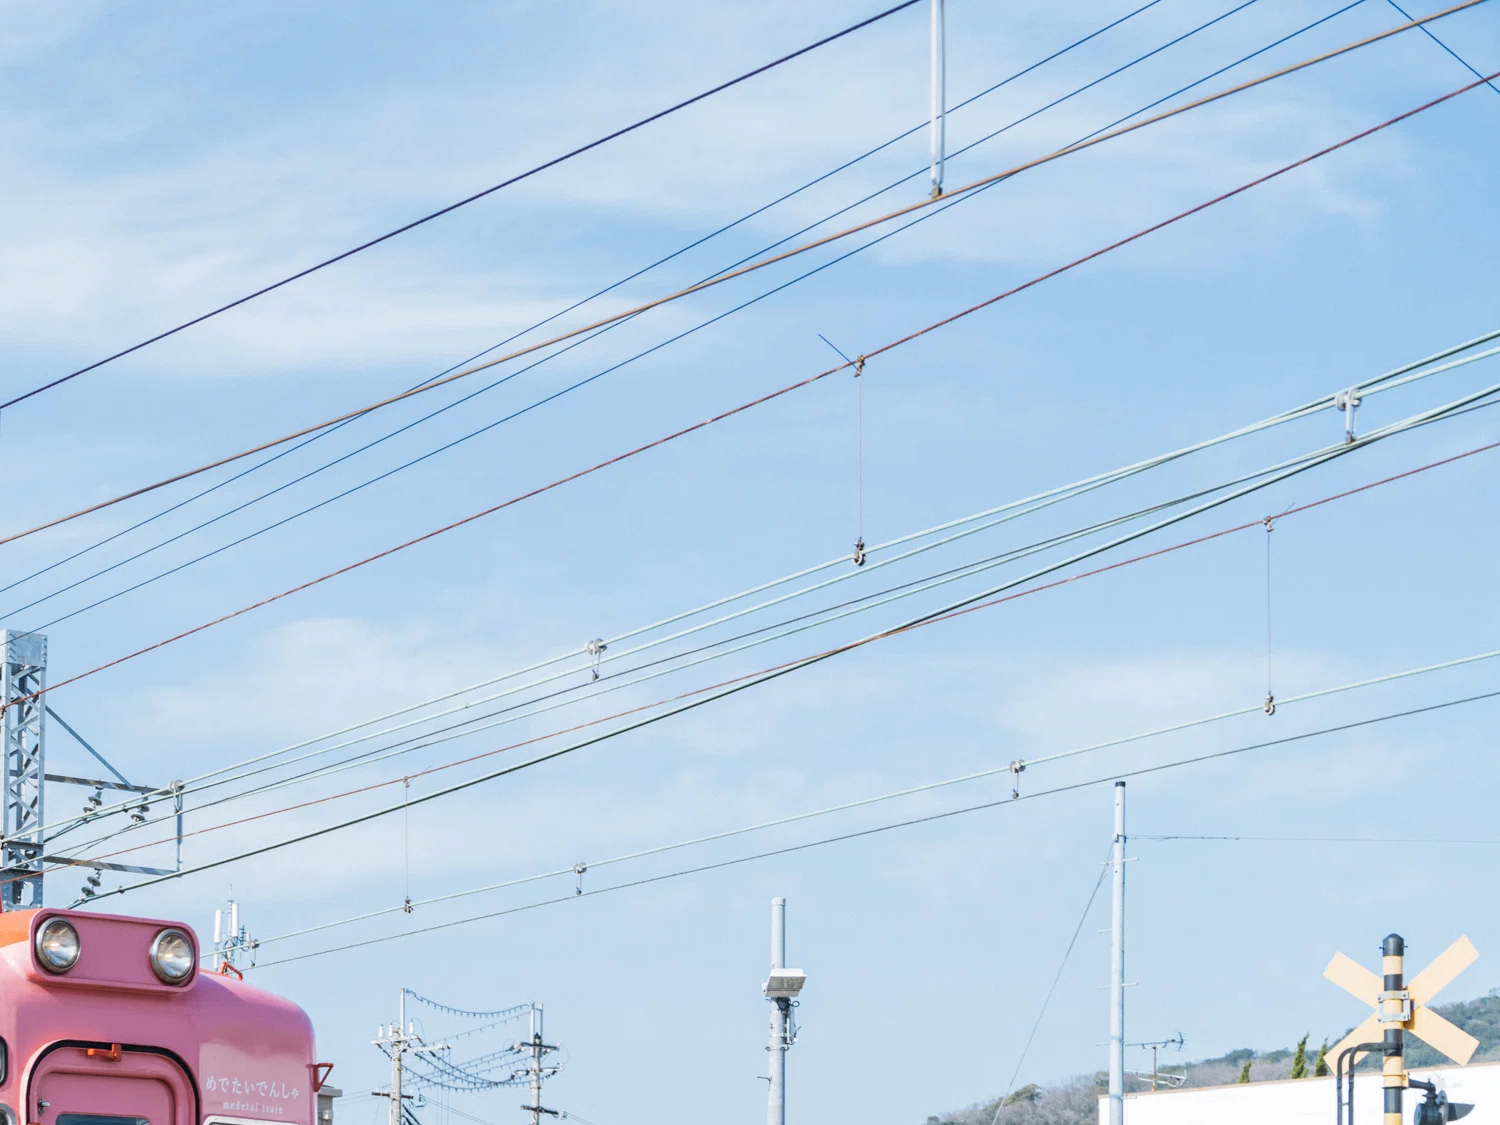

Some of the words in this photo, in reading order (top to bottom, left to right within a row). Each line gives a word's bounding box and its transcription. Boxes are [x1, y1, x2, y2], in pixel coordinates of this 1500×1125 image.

[205, 1075, 300, 1101] めでたいでんしゃ
[222, 1101, 259, 1113] medetai
[261, 1103, 284, 1115] train
